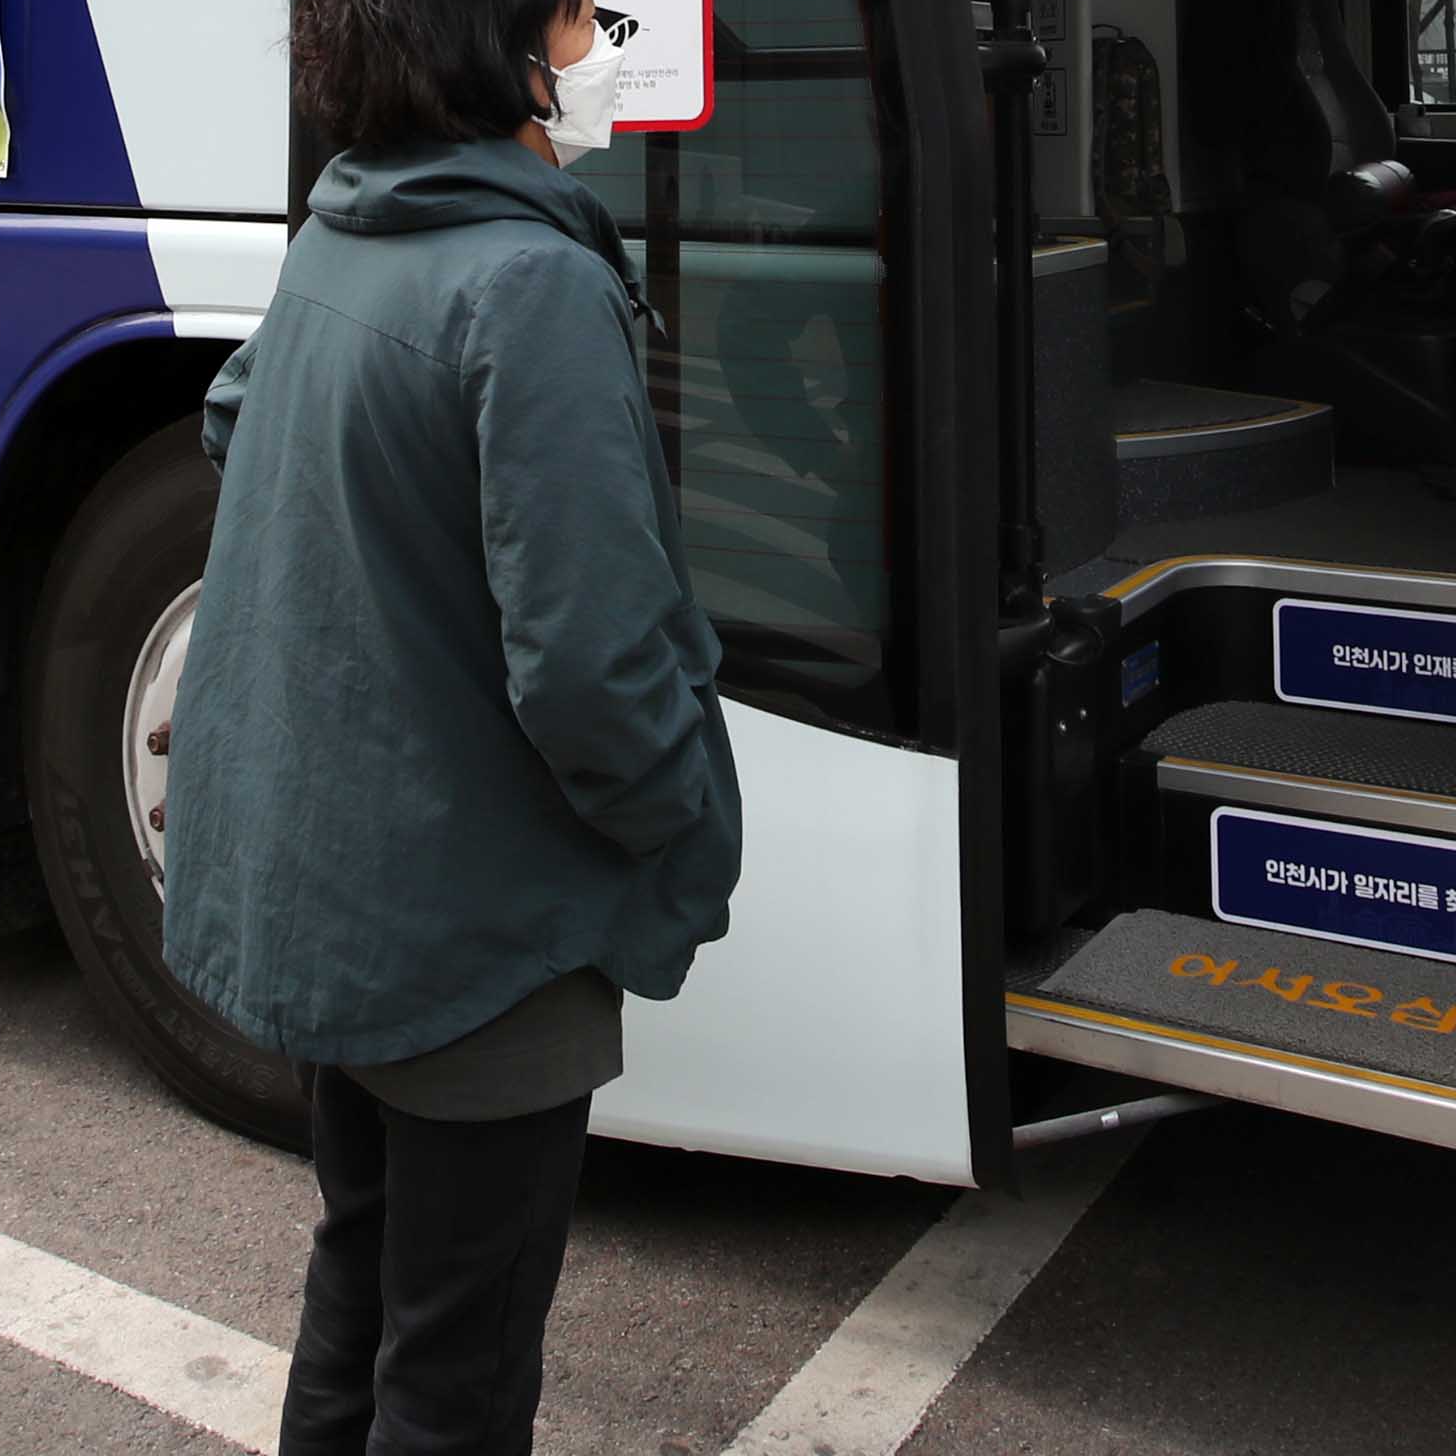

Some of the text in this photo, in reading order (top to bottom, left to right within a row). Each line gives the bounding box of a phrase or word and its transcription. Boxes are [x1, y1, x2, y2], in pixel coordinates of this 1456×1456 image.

[1332, 643, 1409, 673] 인천시가
[1264, 858, 1349, 895] 인천시가
[1353, 872, 1439, 911] 일자리를
